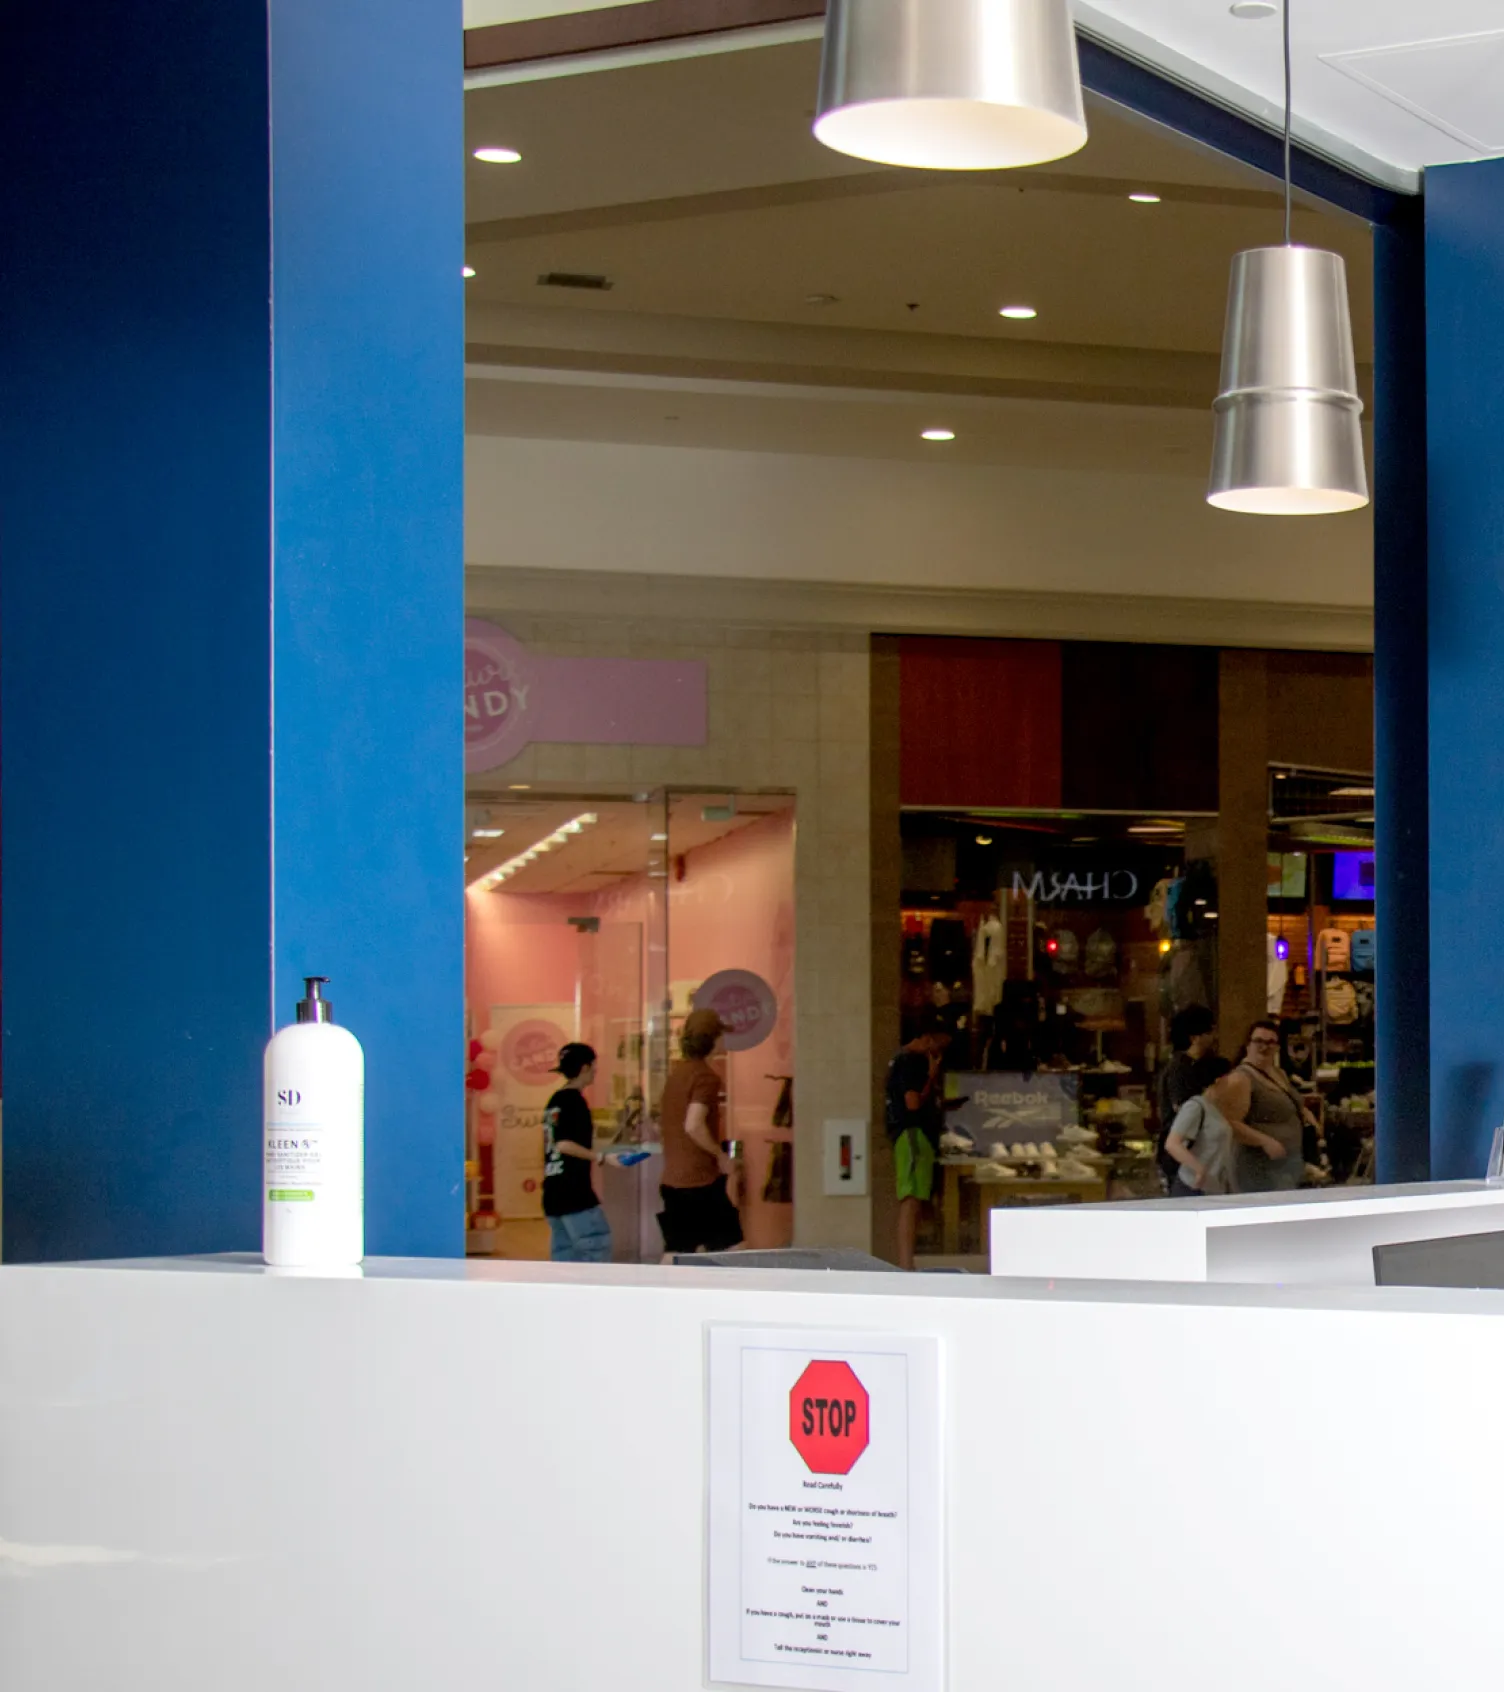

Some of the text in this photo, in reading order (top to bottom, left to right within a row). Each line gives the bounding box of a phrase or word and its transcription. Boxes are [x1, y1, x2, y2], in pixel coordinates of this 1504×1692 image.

[466, 684, 530, 719] NDY
[277, 1088, 302, 1106] SD
[974, 1089, 1048, 1108] Reebok
[801, 1397, 857, 1438] STOP
[803, 1480, 843, 1492] Read Carefully
[767, 1503, 779, 1512] have
[784, 1504, 797, 1512] NEW
[812, 1520, 829, 1529] feeling
[792, 1531, 805, 1540] have
[801, 1585, 815, 1593] Clean
[816, 1599, 828, 1608] AND
[816, 1633, 828, 1641] AND
